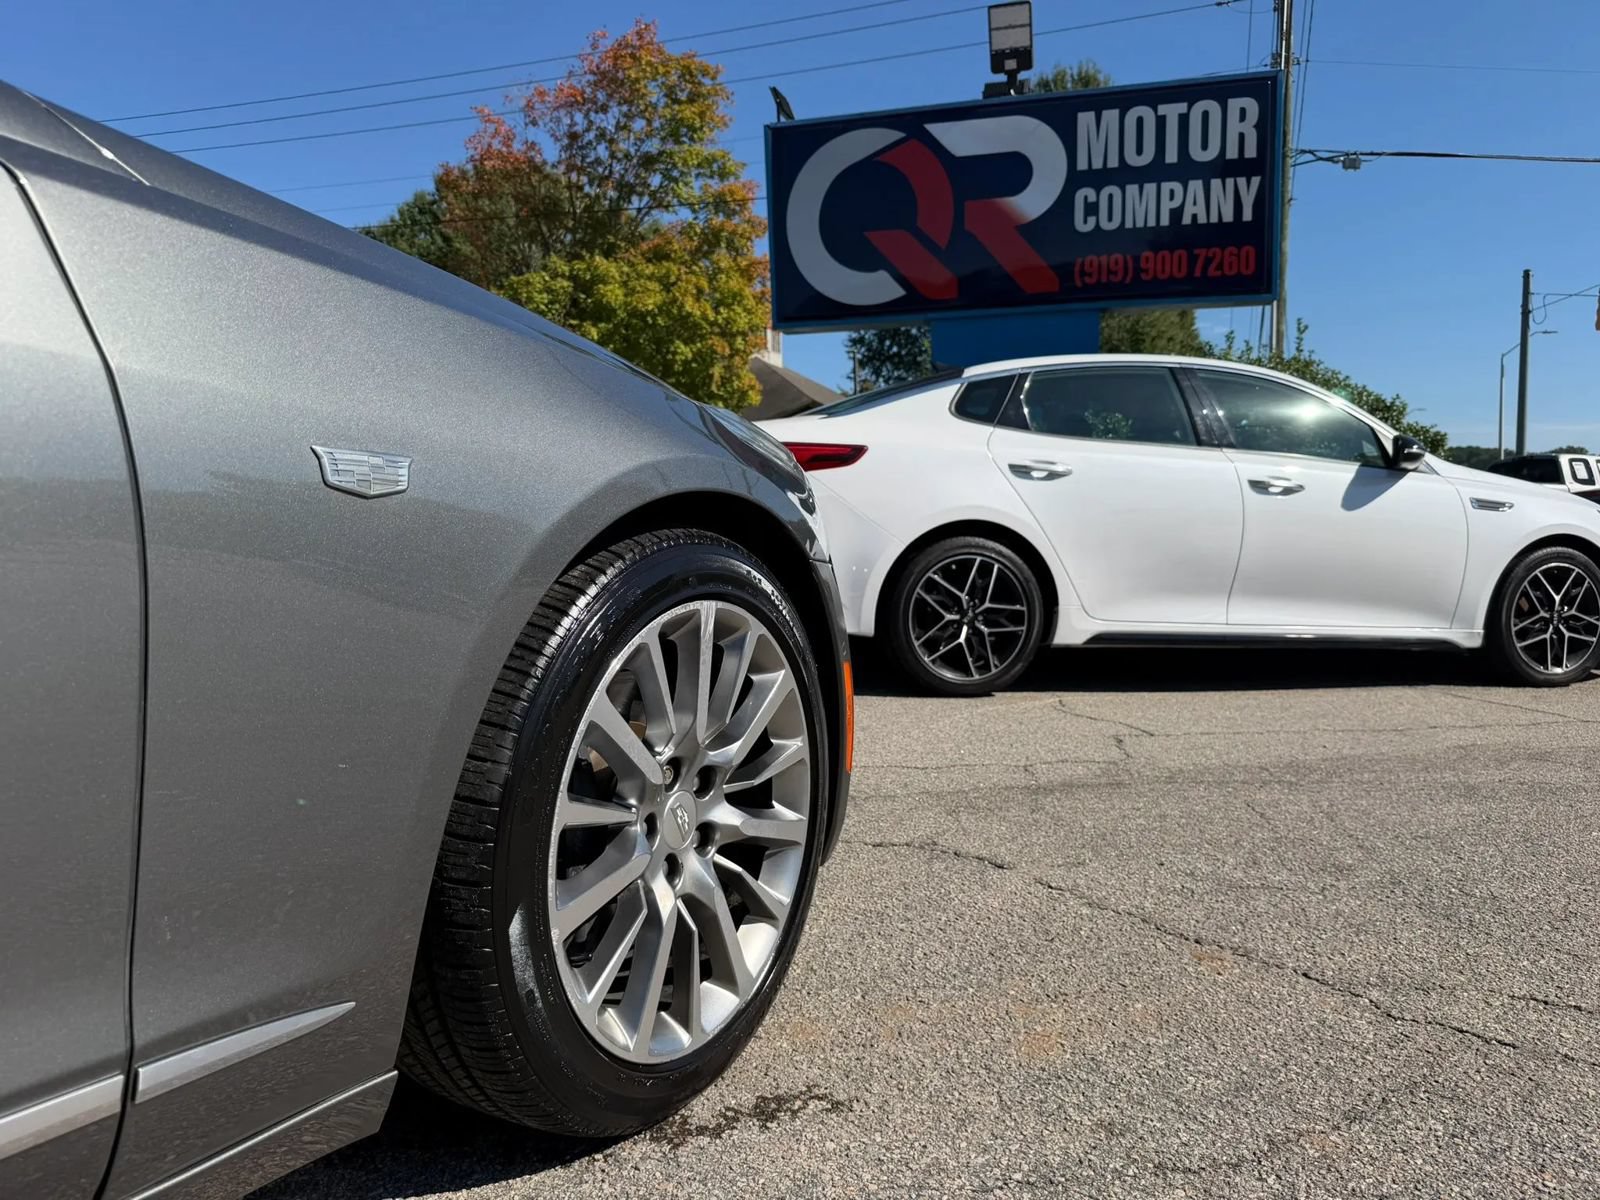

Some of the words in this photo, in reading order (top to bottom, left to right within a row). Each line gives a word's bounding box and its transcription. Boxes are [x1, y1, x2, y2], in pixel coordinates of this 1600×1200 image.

[1076, 97, 1259, 171] MOTOR
[787, 115, 1068, 305] QR
[1074, 176, 1261, 233] COMPANY
[1074, 253, 1133, 287] (919)
[1140, 249, 1188, 280] 900
[1194, 245, 1256, 278] 7260
